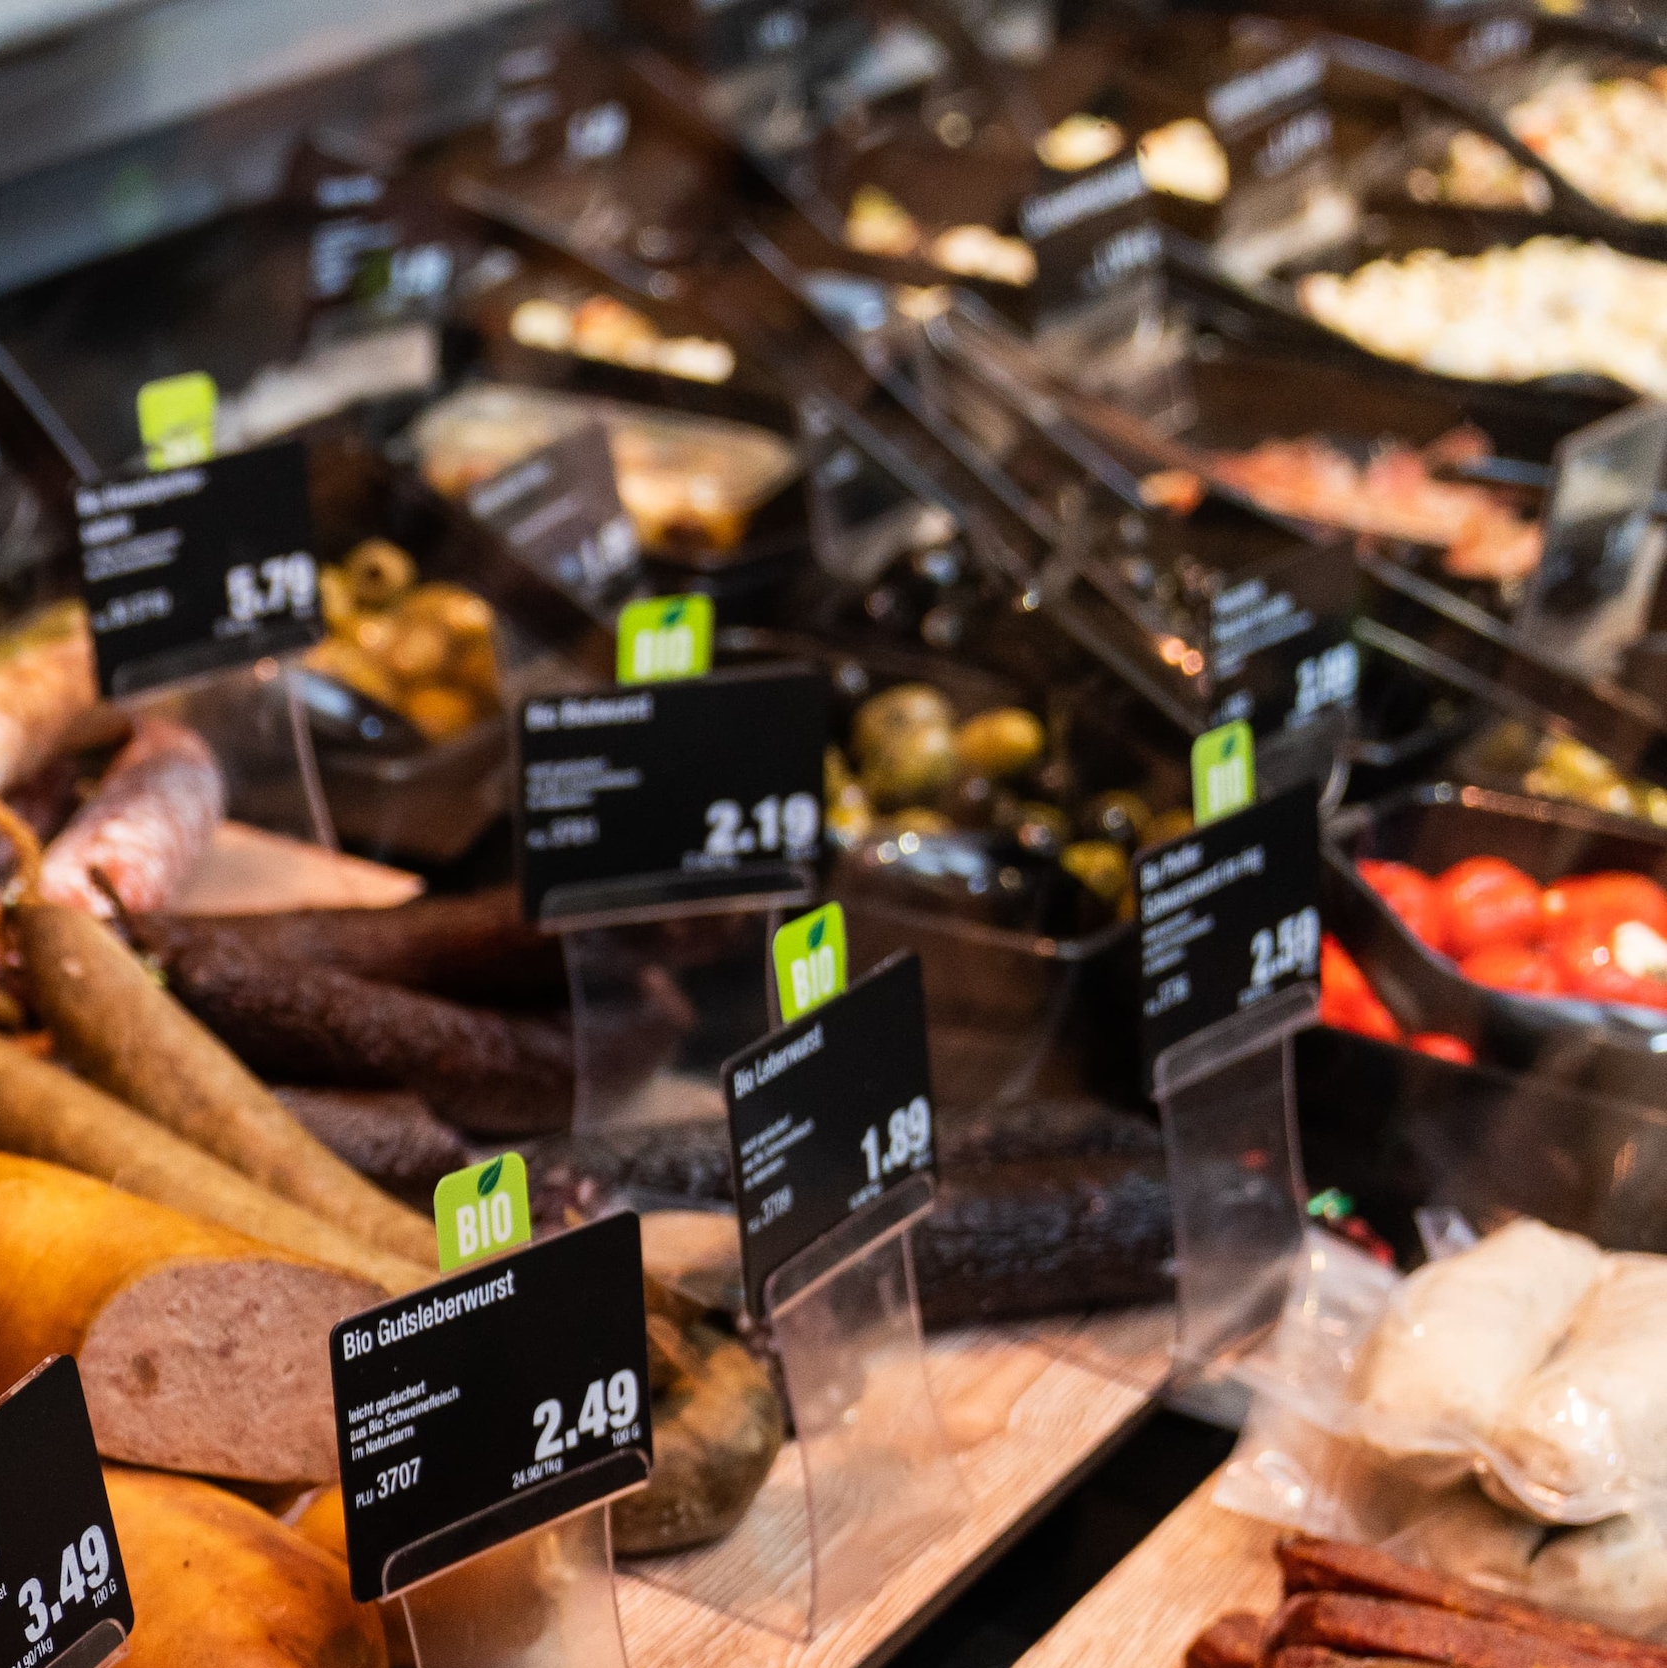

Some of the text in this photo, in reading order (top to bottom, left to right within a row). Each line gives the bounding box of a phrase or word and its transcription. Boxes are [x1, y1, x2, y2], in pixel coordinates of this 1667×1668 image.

[634, 625, 694, 678] BIO
[791, 945, 836, 1010] BIO
[734, 1021, 825, 1100] Bio Leberwurst
[860, 1095, 931, 1181] 1.89
[455, 1191, 513, 1259] BIO
[342, 1268, 515, 1362] Bio Gutsleberwurst
[348, 1379, 427, 1424] leicht geräuchert
[350, 1384, 462, 1443] aus Bio Schweinefleisch
[532, 1368, 639, 1462] 2.49
[351, 1424, 415, 1461] im Naturdarm
[611, 1426, 630, 1448] 100
[355, 1455, 423, 1509] PLU 3707
[512, 1456, 565, 1490] 24.90/1kg
[18, 1524, 110, 1643] 3.49
[92, 1578, 118, 1609] 100 G
